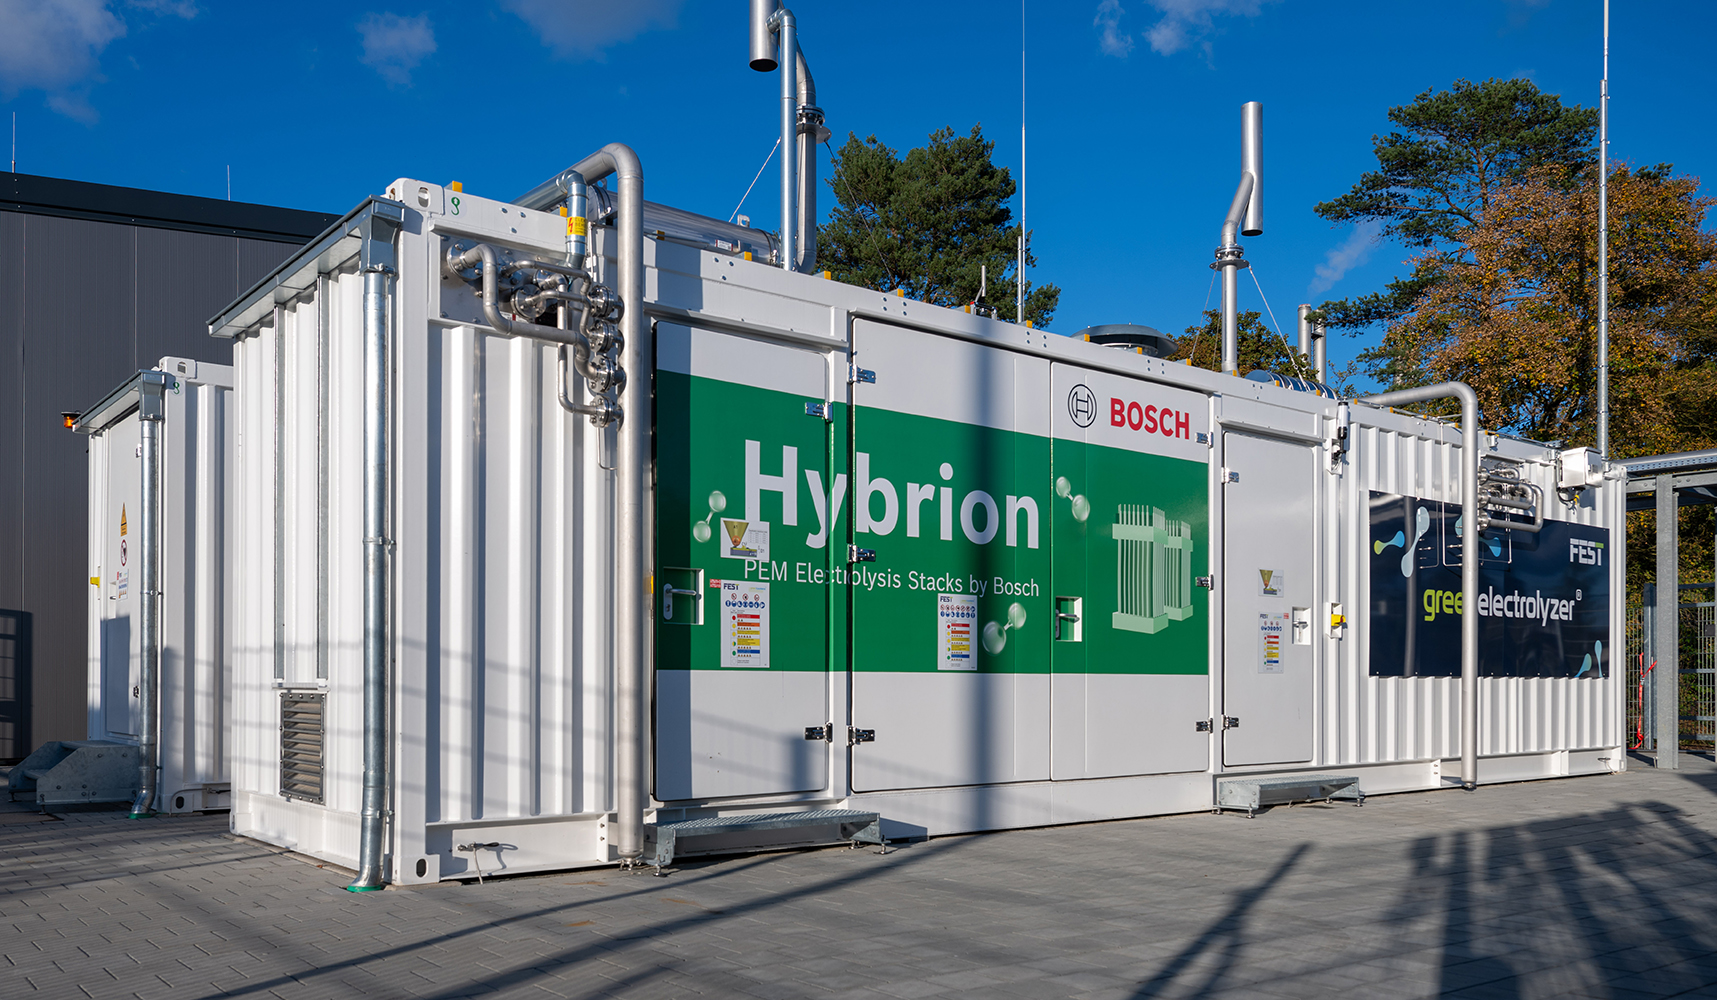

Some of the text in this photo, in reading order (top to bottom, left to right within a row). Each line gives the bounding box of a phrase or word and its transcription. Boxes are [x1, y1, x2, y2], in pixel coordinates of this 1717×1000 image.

[1110, 397, 1189, 440] BOSCH
[745, 438, 1039, 550] Hybrion
[1570, 538, 1604, 566] FEST
[744, 559, 788, 582] PEM
[908, 570, 963, 593] Stacks
[969, 574, 988, 598] by
[993, 576, 1039, 597] Bosch
